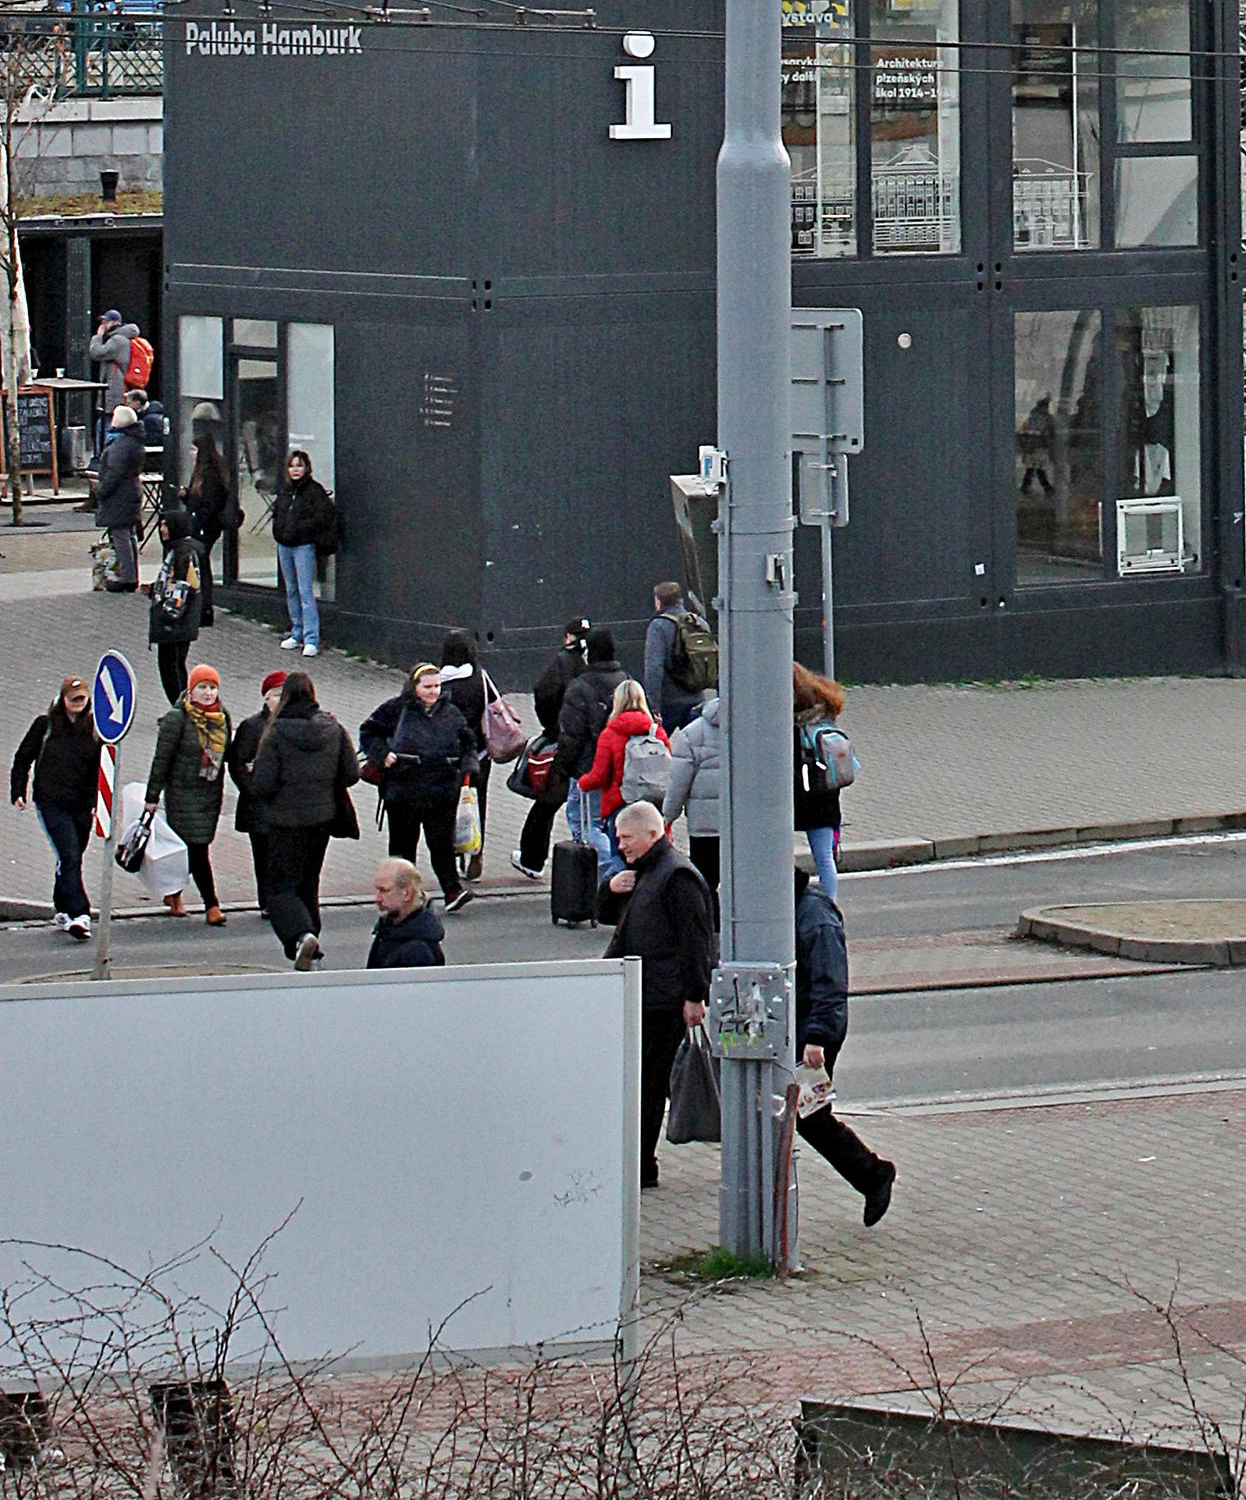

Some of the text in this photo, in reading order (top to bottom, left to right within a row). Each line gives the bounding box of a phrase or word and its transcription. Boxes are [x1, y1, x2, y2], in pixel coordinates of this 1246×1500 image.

[185, 21, 363, 56] Paluba Hamburk
[875, 72, 935, 86] plzeňských
[874, 86, 897, 99] škol
